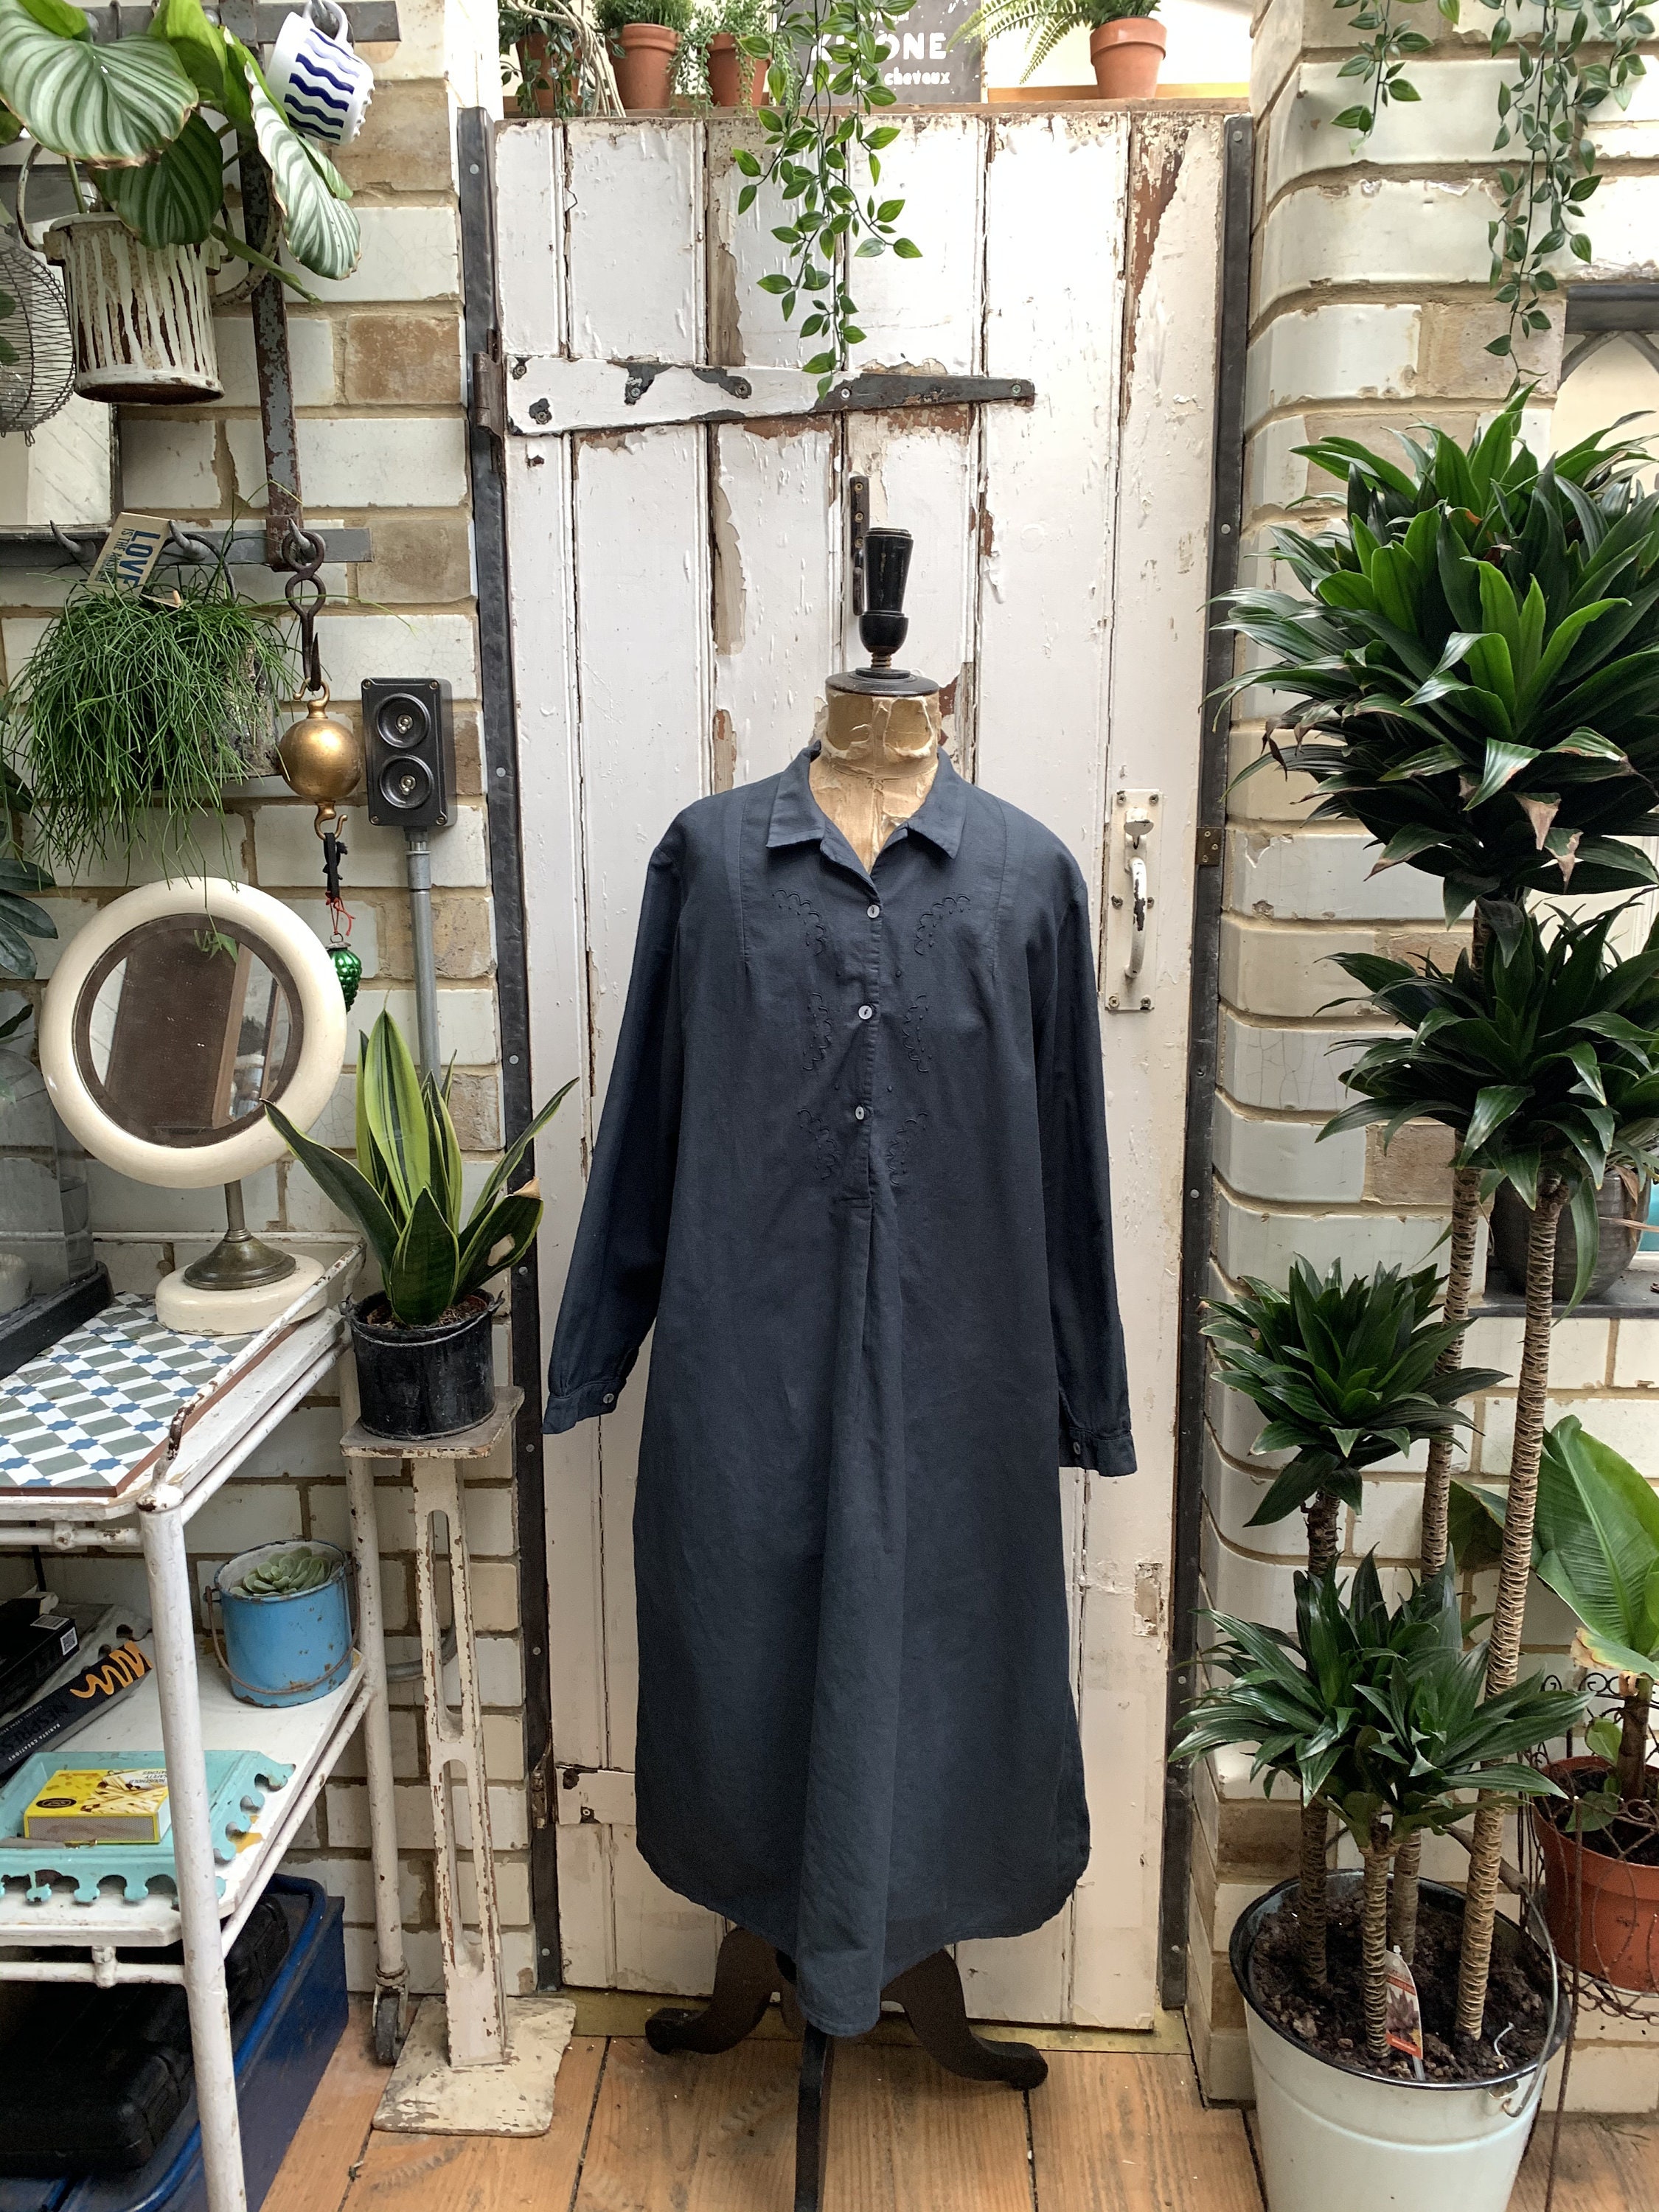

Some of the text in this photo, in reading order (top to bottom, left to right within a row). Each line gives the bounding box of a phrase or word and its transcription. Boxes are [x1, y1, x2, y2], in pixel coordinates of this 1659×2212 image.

[114, 538, 131, 551] THE
[121, 528, 135, 536] IS
[113, 530, 161, 588] LOVE
[8, 1723, 60, 1761] BARISTA CREATIONS
